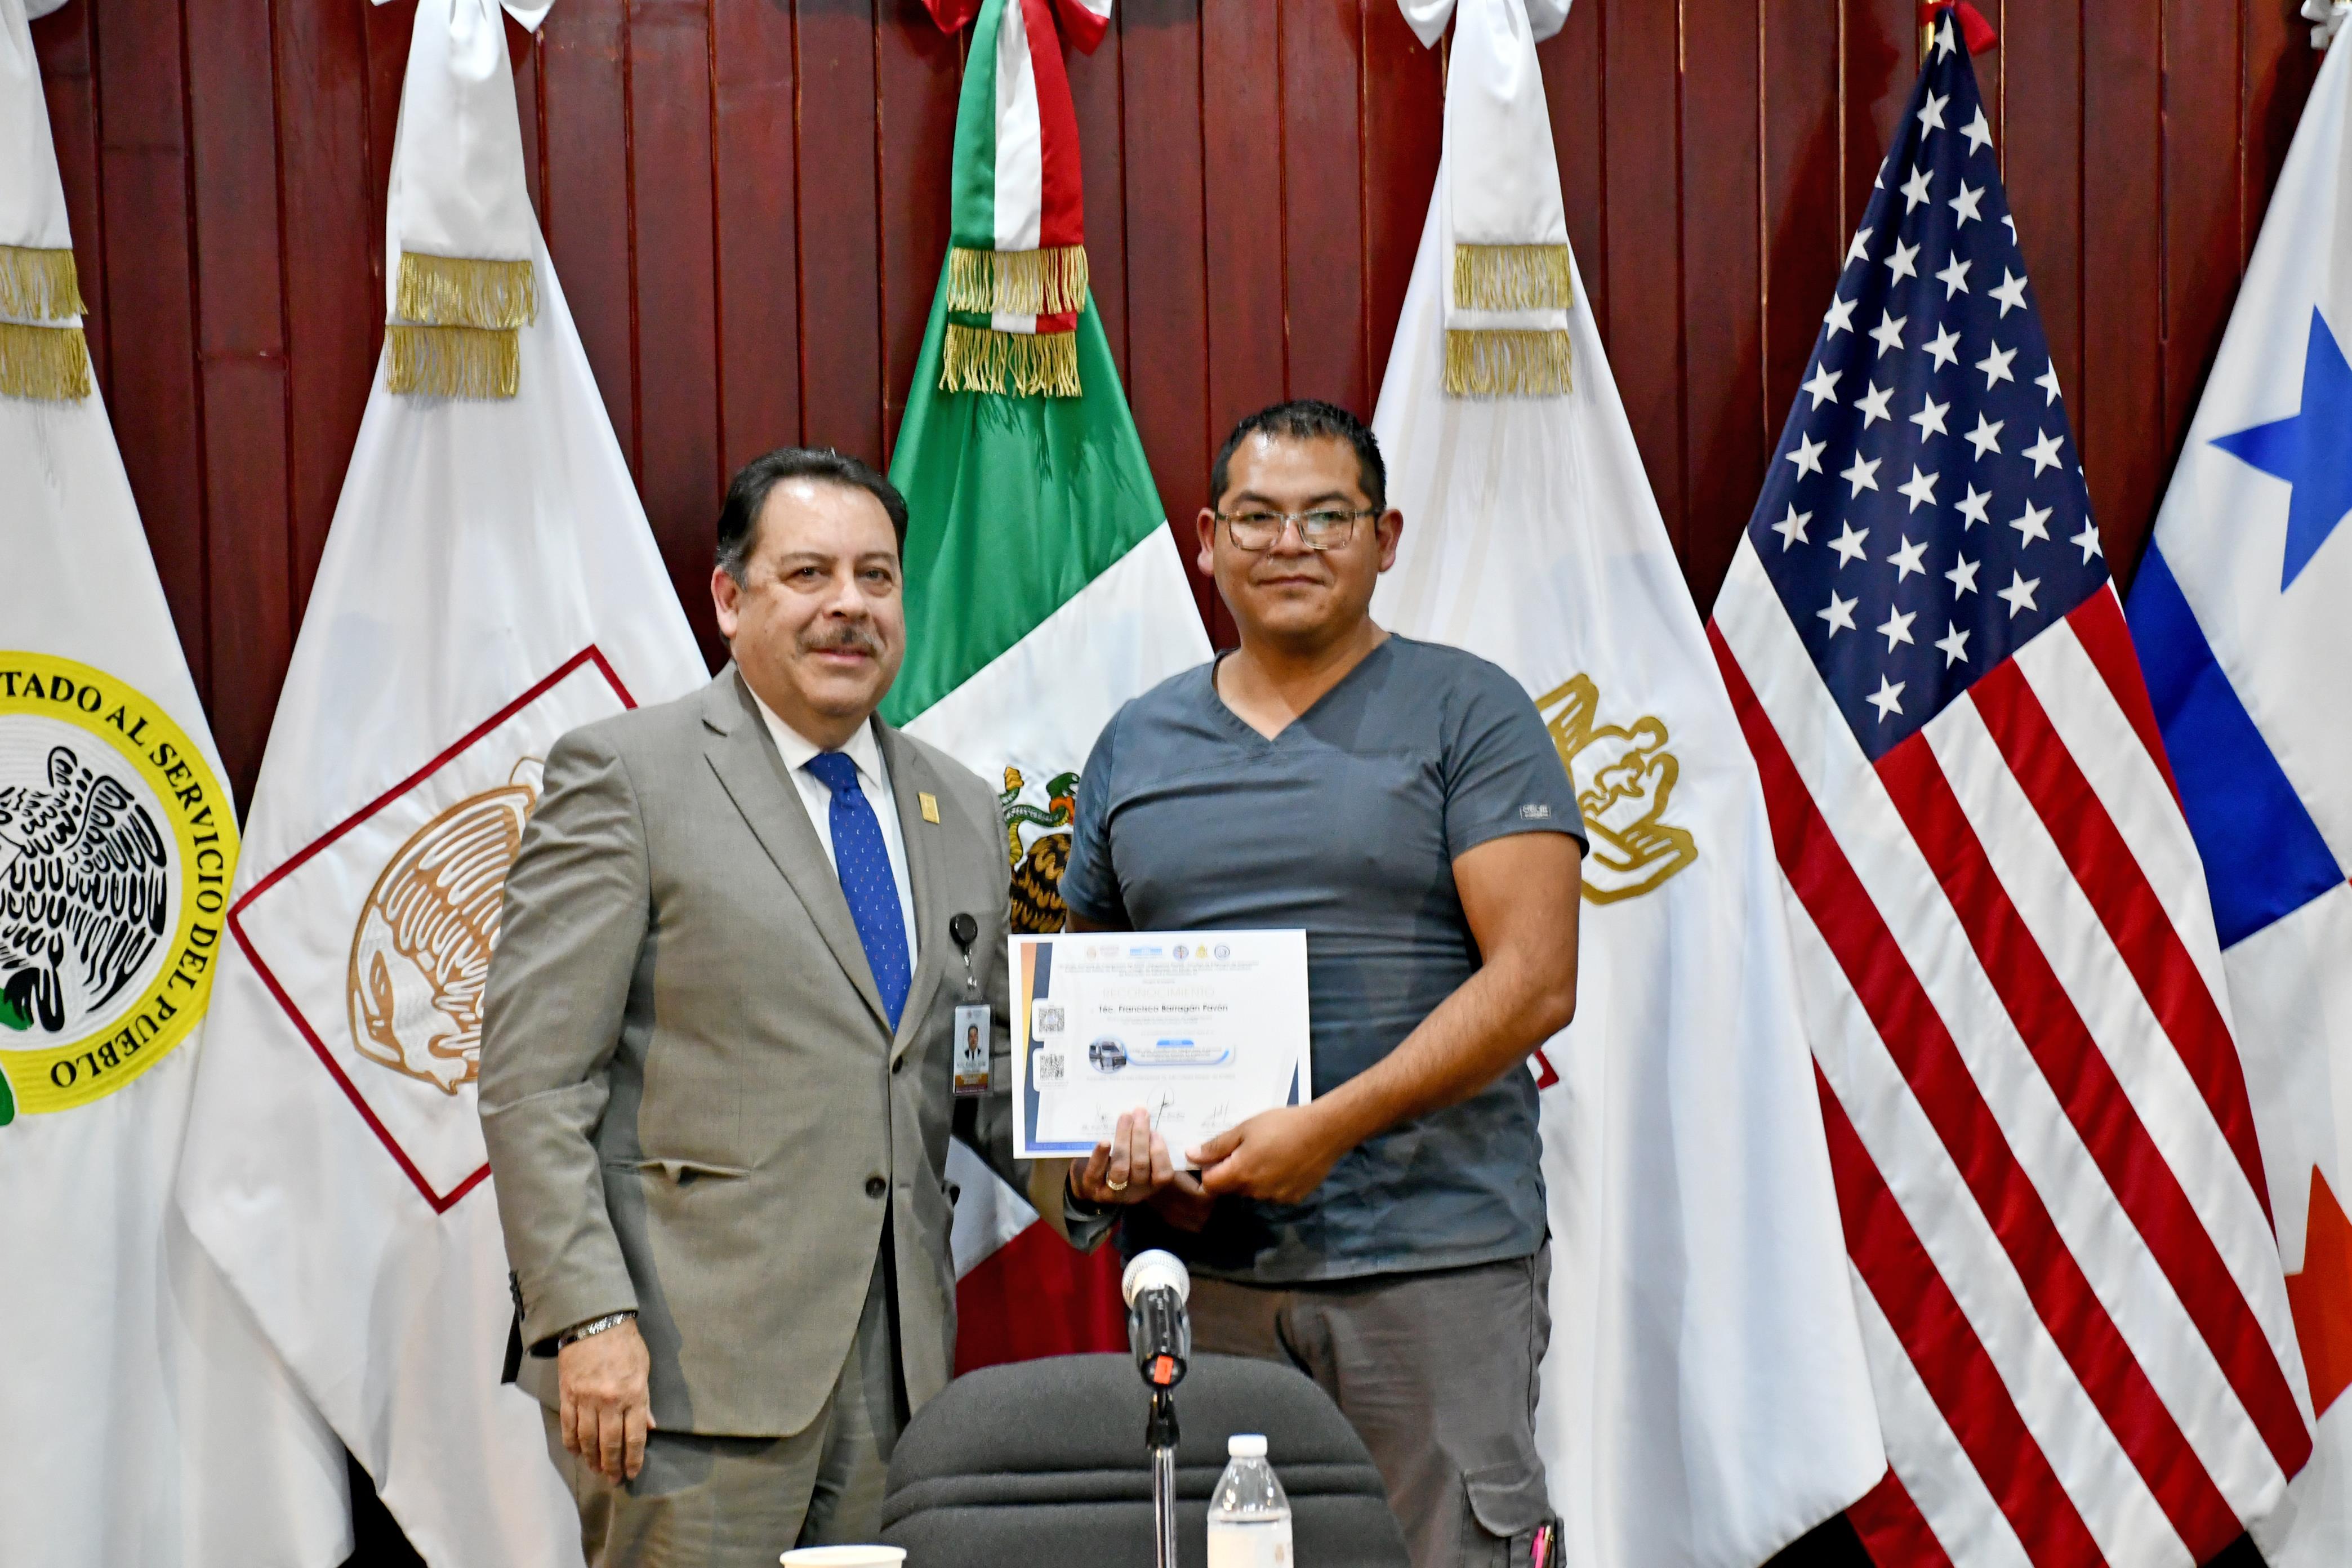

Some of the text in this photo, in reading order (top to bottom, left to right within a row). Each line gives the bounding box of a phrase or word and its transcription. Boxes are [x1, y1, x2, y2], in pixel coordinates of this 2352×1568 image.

[0, 671, 224, 1088] TADO AL SERVICIO DEL PUEBLO
[1119, 1004, 1159, 1014] Francisco
